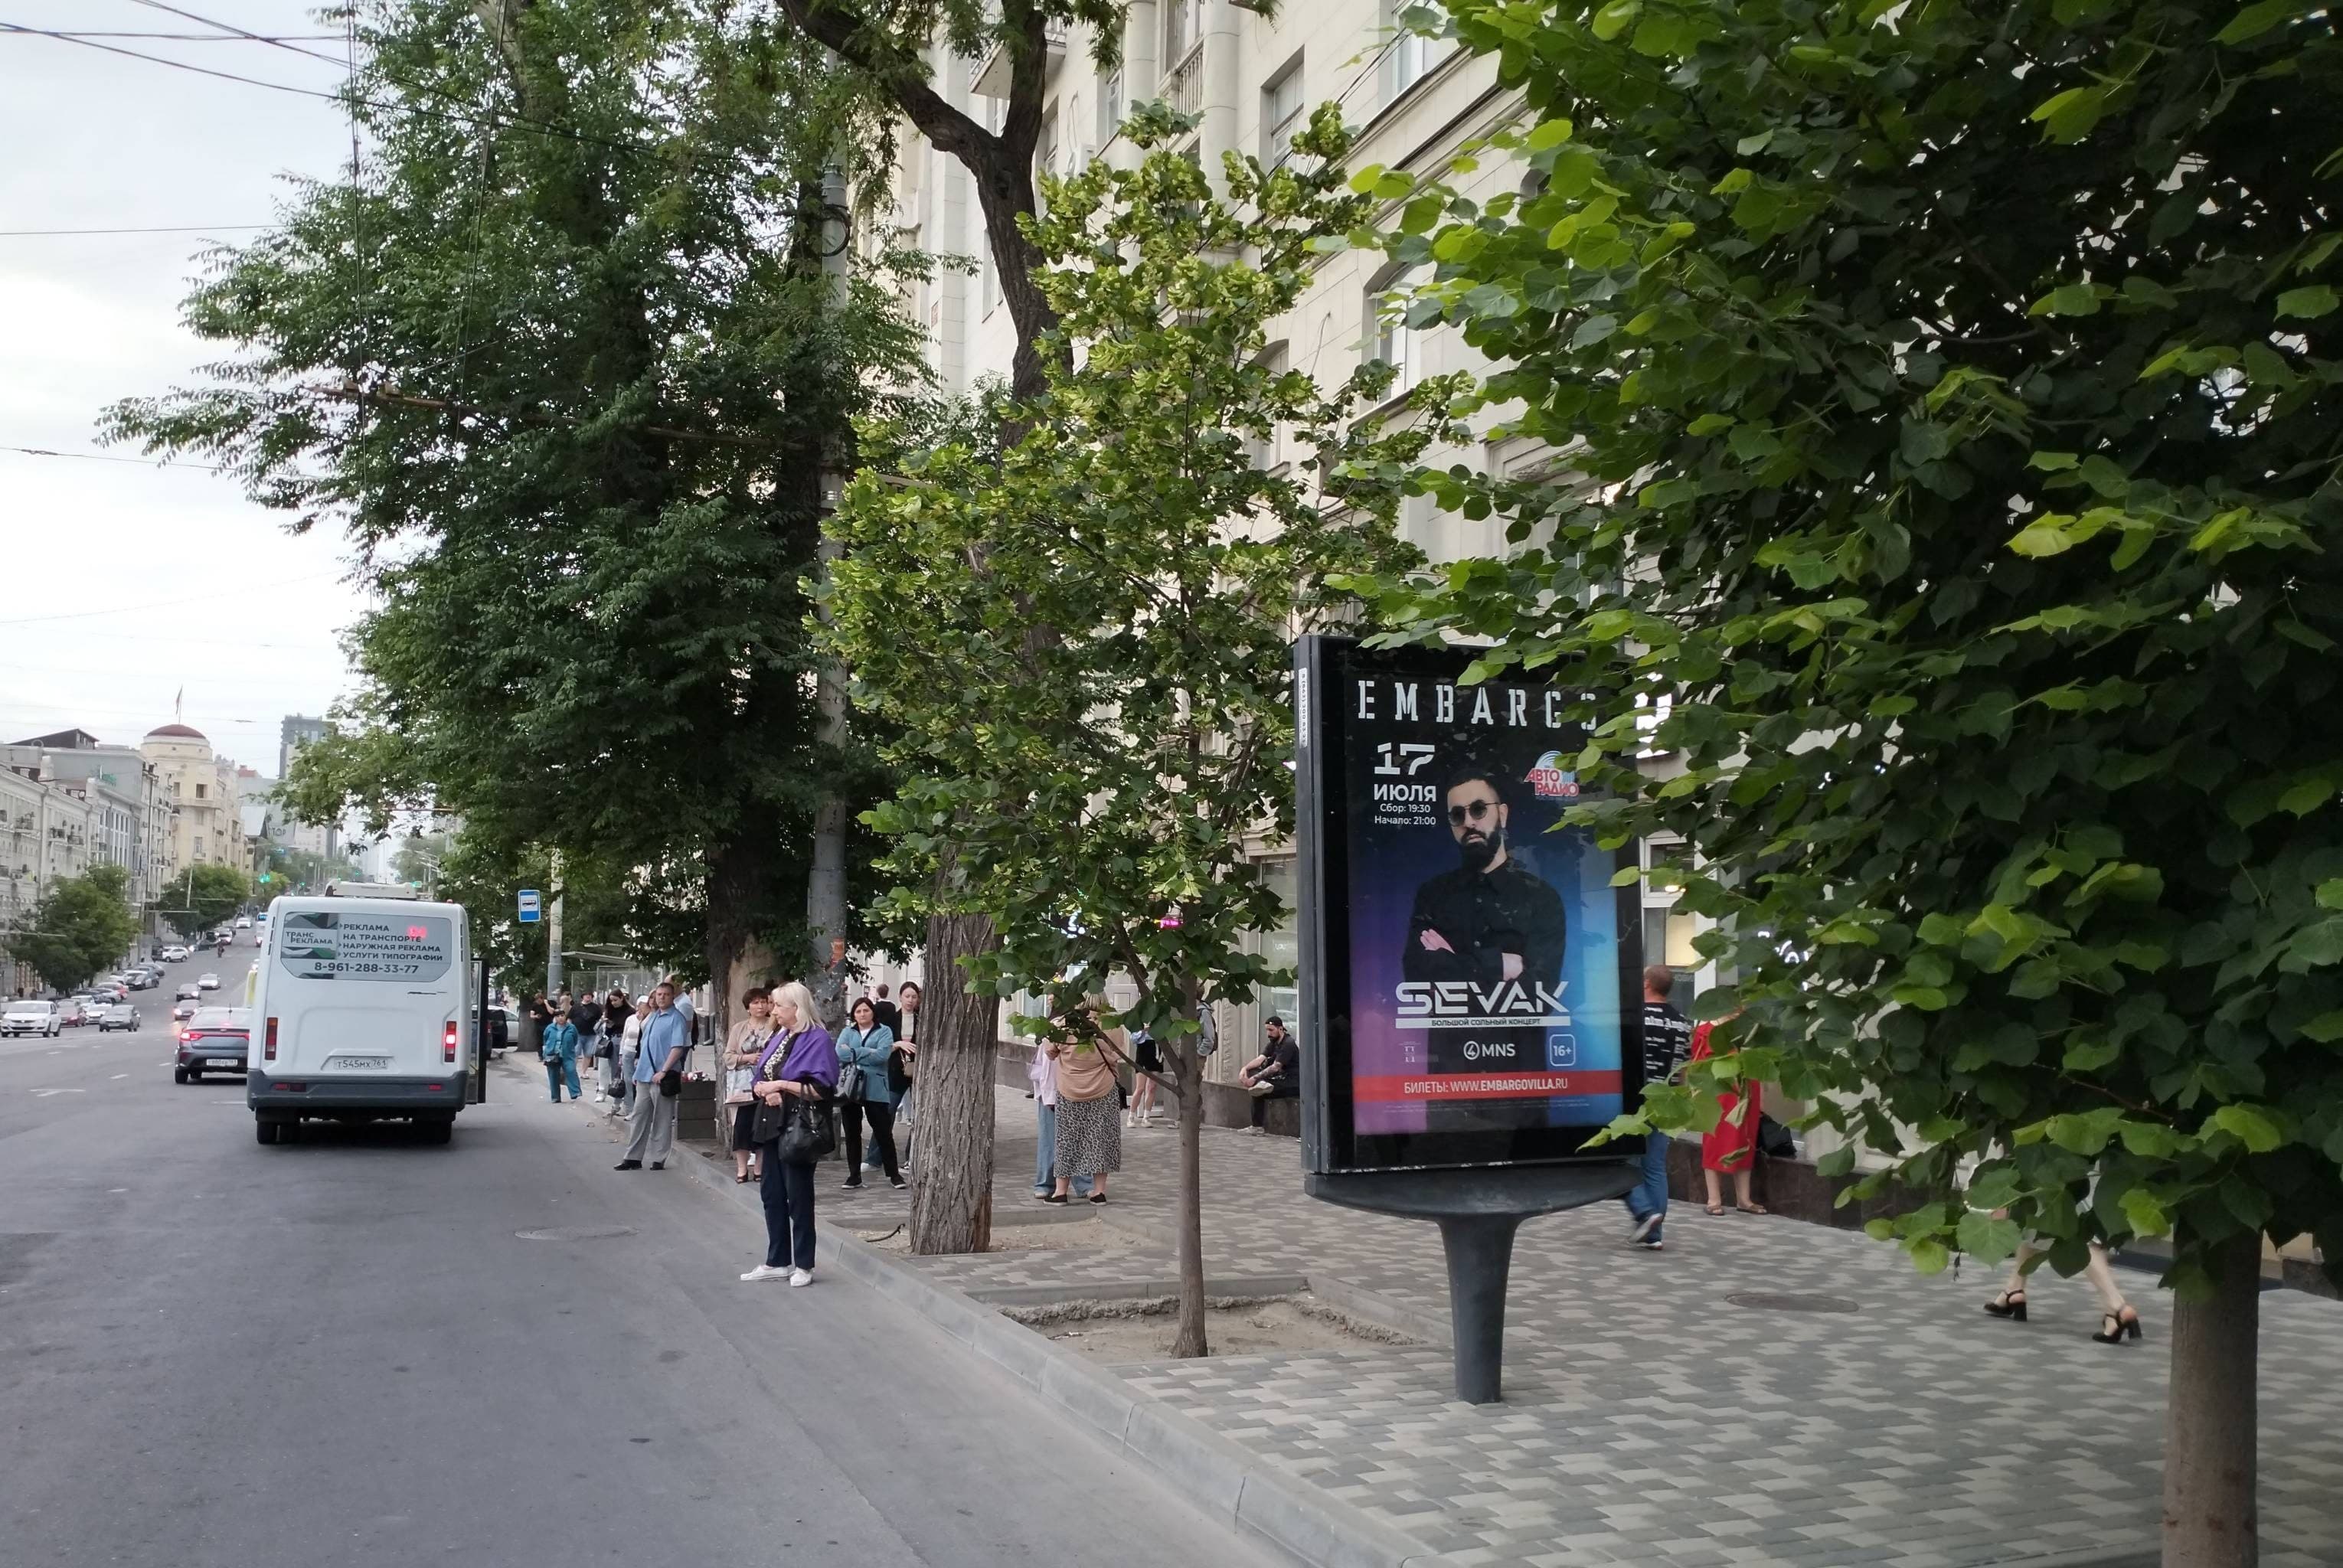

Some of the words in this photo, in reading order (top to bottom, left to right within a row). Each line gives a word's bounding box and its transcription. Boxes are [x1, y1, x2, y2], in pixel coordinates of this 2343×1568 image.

[1374, 742, 1436, 776] 17
[1526, 769, 1560, 782] АВТО
[1374, 783, 1436, 802] ИЮЛЯ
[1535, 782, 1580, 796] РАДИО
[1380, 803, 1407, 814] Сбор:
[1408, 804, 1431, 813] 19:30
[1374, 815, 1412, 825] Начало:
[1413, 816, 1436, 825] 21:00
[344, 923, 390, 932] РЕКЛАМА
[359, 934, 421, 942] ТРАНСПОРТЕ
[343, 942, 396, 951] НАРУЖНАЯ
[398, 944, 441, 952] РЕКЛАМА
[382, 952, 443, 962] ТИПОГРАФИИ
[314, 962, 420, 974] 8-961-288-33-77
[1395, 981, 1570, 1015] SEVAK
[1432, 1018, 1469, 1027] БОЛЬШОЙ
[1482, 1044, 1516, 1057] MNS
[1553, 1045, 1572, 1057] 16+
[1404, 1081, 1449, 1094] БИЛЕТЫ:
[1450, 1078, 1568, 1093] WWW.EMBARGOVILLA.RU
